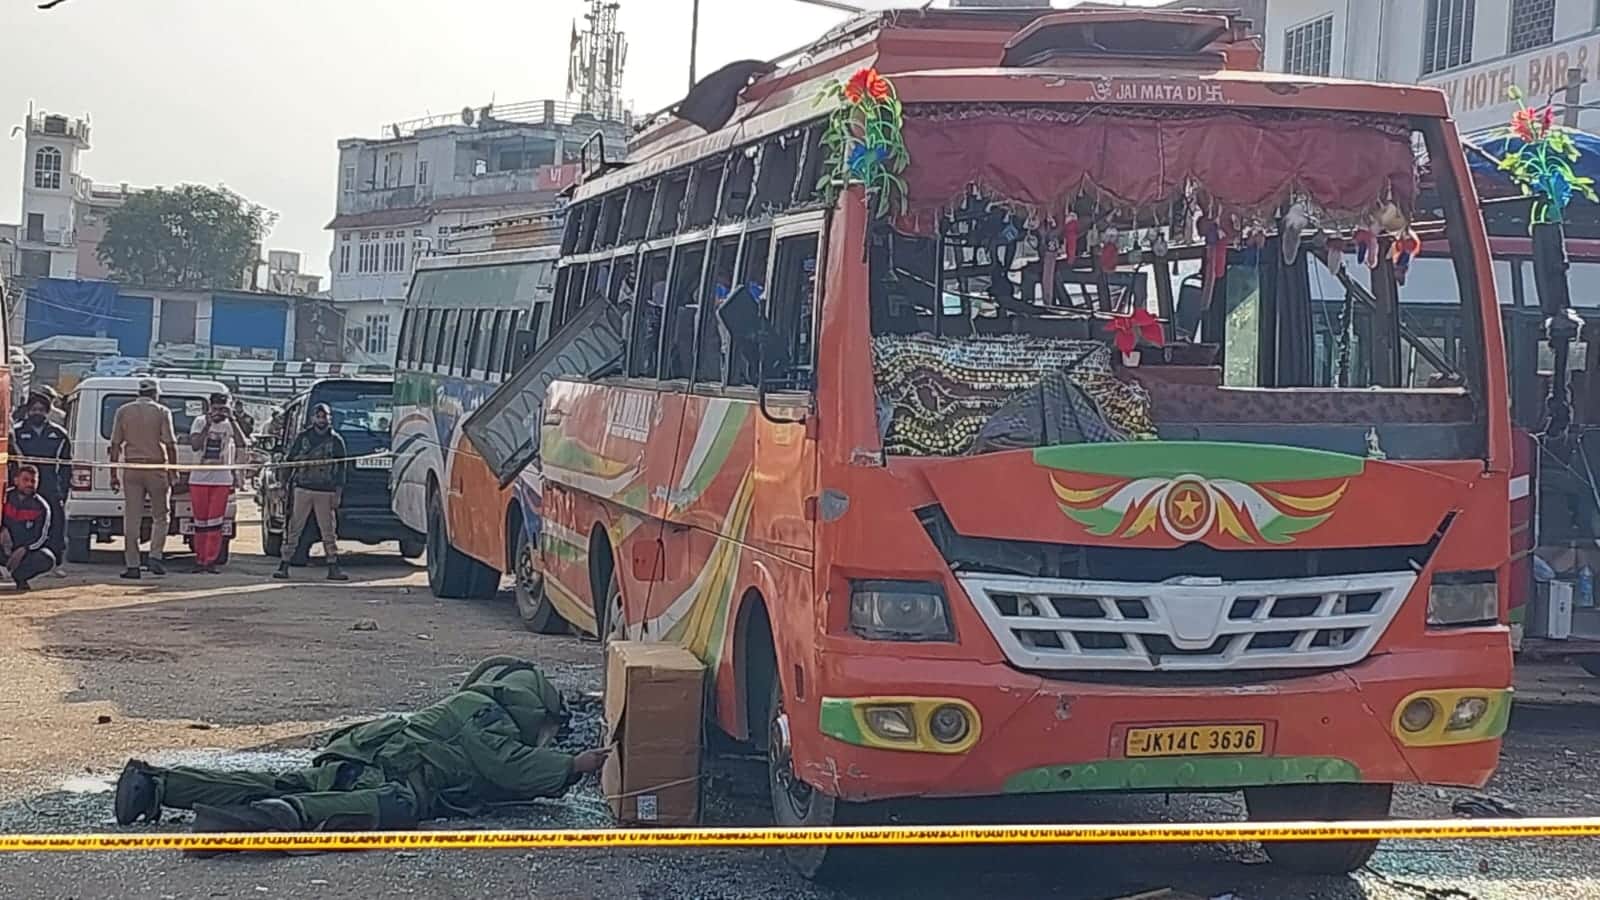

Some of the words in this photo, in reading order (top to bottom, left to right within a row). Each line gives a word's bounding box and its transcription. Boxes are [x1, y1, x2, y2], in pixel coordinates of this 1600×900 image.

[1115, 84, 1137, 101] JAI
[1140, 84, 1183, 101] MATA
[1187, 85, 1202, 101] DI
[1462, 64, 1516, 112] HOTEL
[1528, 51, 1569, 97] BAR
[1141, 731, 1200, 752] JK14C
[1209, 729, 1256, 749] 3636
